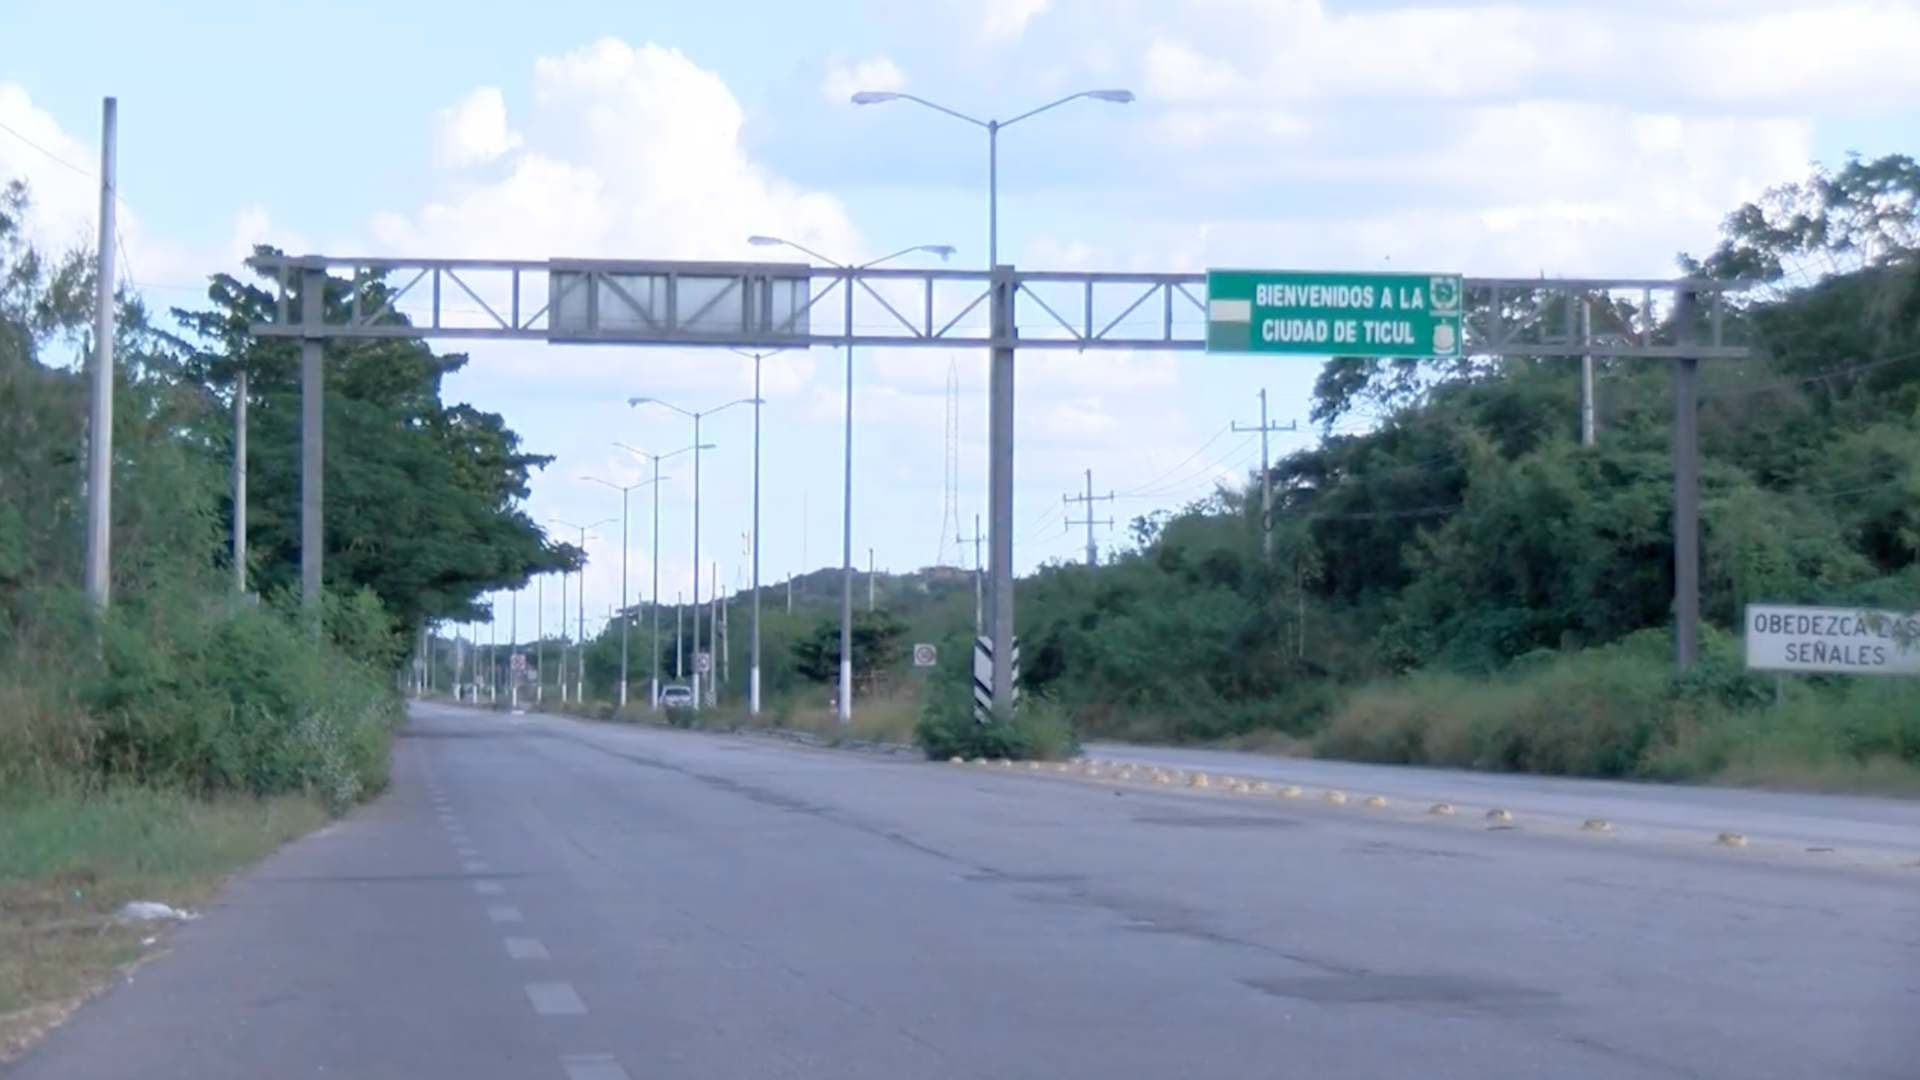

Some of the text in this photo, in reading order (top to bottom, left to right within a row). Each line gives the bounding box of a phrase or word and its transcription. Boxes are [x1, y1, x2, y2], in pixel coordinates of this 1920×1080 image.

[1256, 283, 1424, 310] BIENVENIDOS A LA
[1262, 319, 1415, 344] CIUDAD DE TICUL
[1754, 612, 1867, 637] OBEDEZCA
[1785, 640, 1886, 666] SEÑALES
